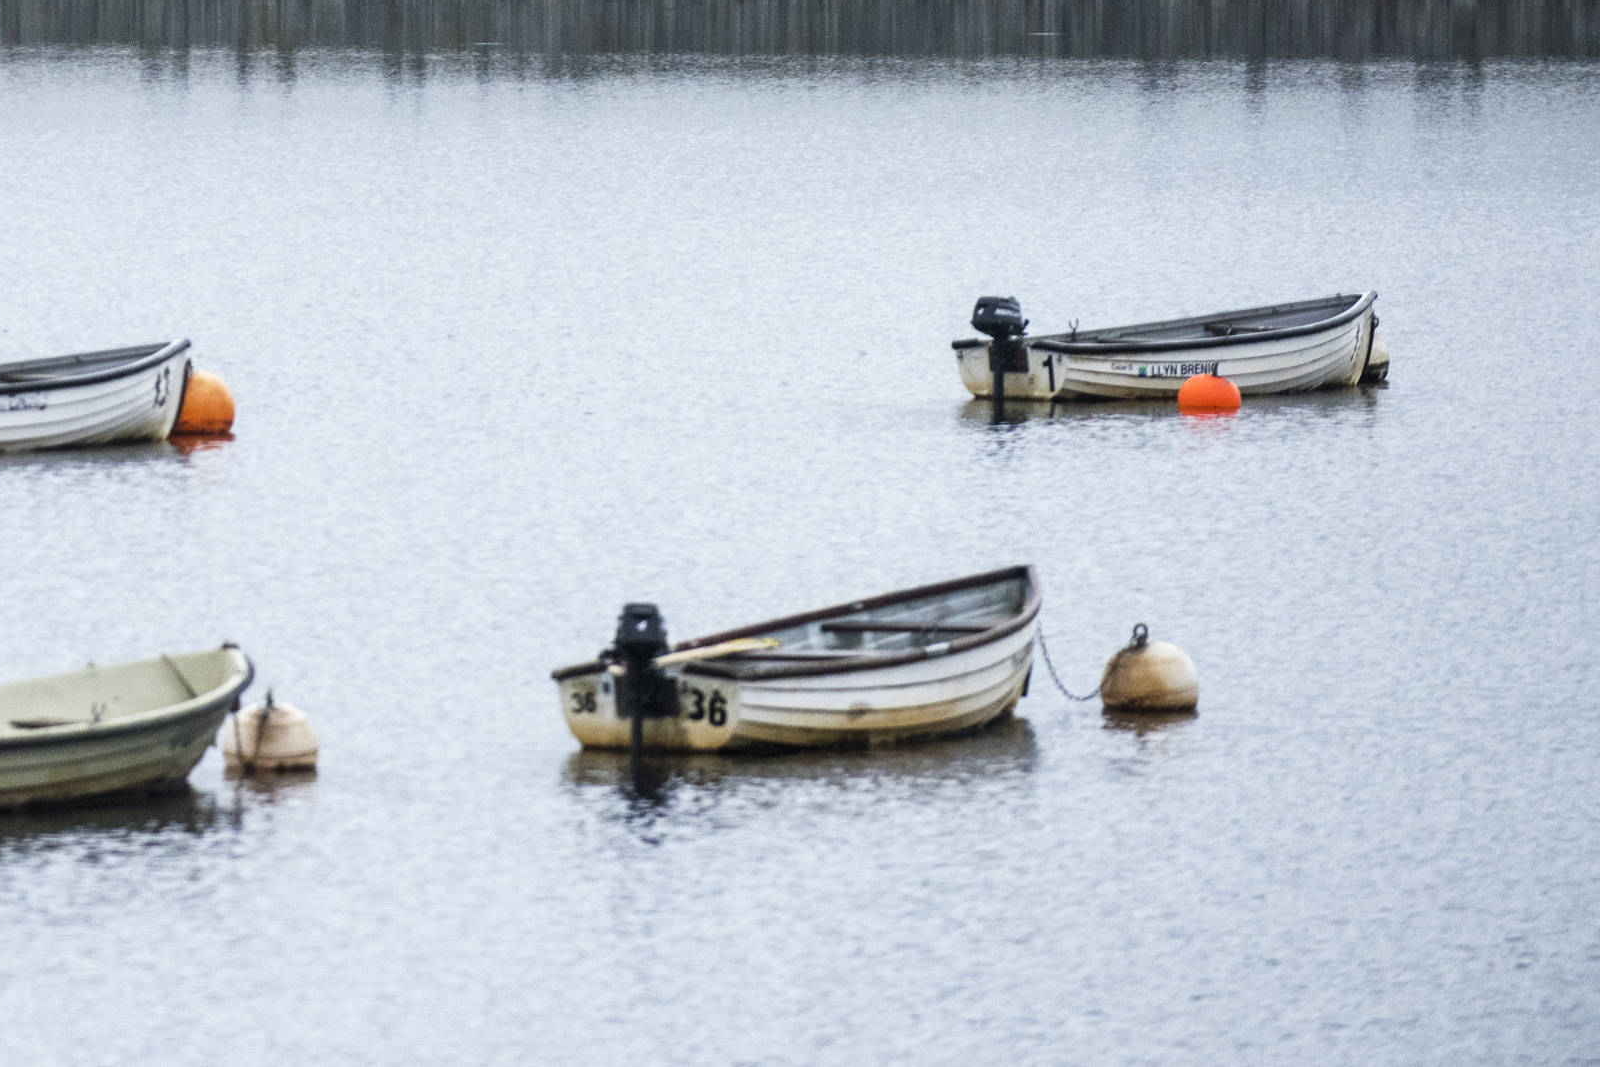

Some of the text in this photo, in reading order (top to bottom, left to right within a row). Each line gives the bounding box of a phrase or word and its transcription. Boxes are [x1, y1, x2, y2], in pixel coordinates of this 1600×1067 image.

[1042, 354, 1056, 392] 1
[1151, 364, 1178, 375] LLYN
[571, 691, 597, 713] 36
[689, 688, 728, 727] 36
